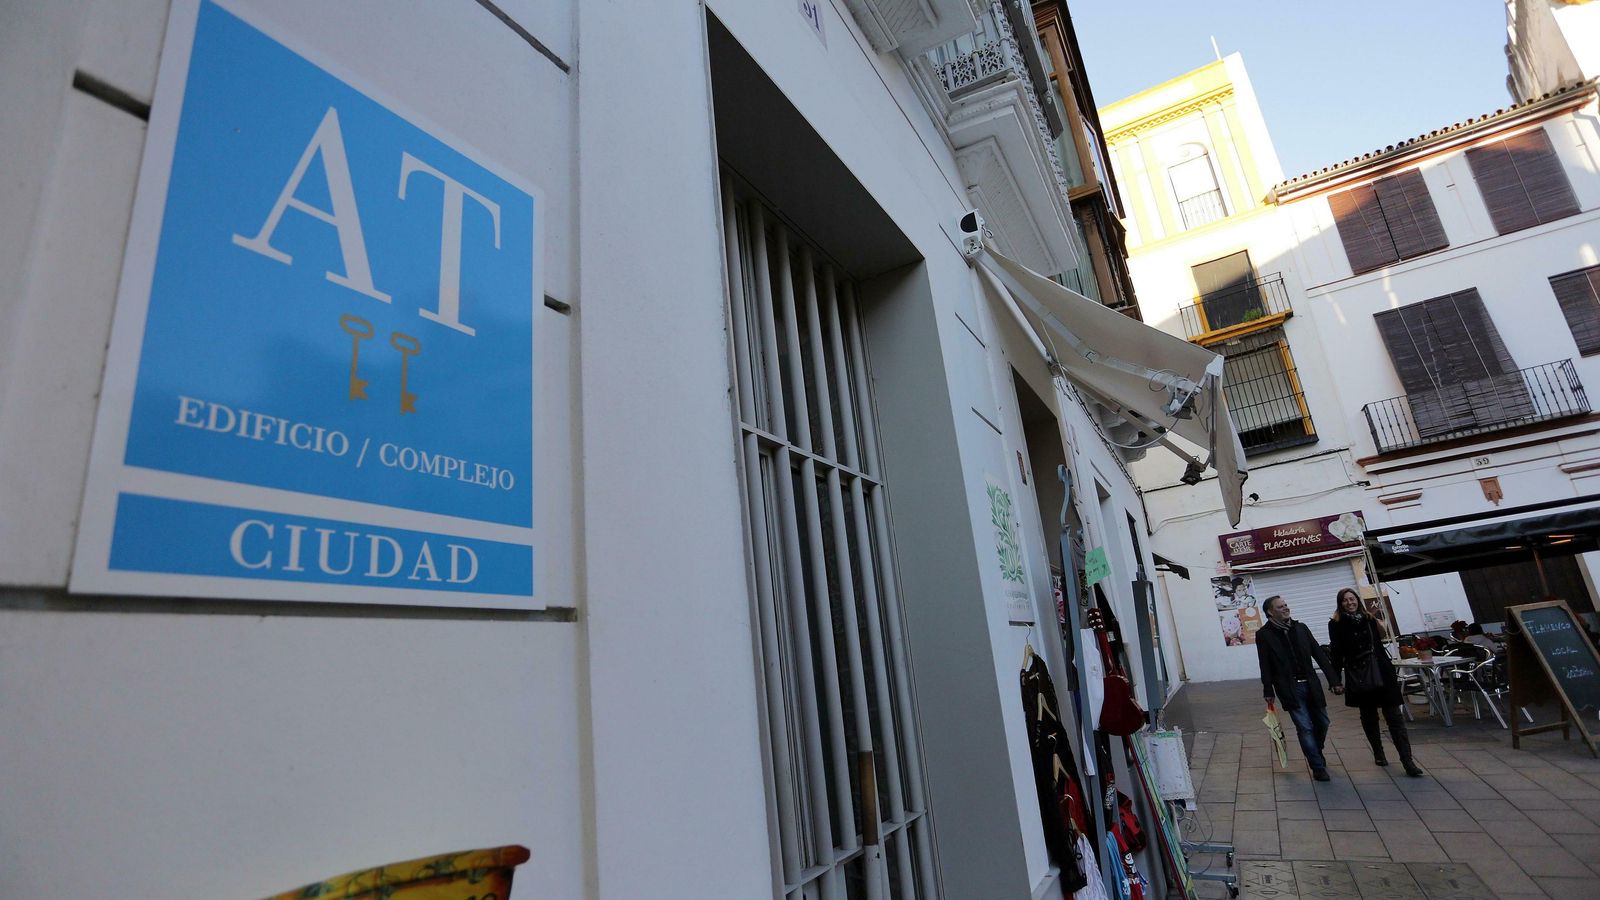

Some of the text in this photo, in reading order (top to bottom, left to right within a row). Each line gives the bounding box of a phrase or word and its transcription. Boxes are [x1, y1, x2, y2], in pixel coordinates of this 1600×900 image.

[232, 106, 501, 336] AT
[175, 396, 349, 457] EDIFICIO
[379, 442, 515, 491] COMPLEJO
[229, 519, 479, 584] CIUDAD
[1229, 540, 1252, 549] CARTE
[1263, 534, 1322, 551] PLACENTINES
